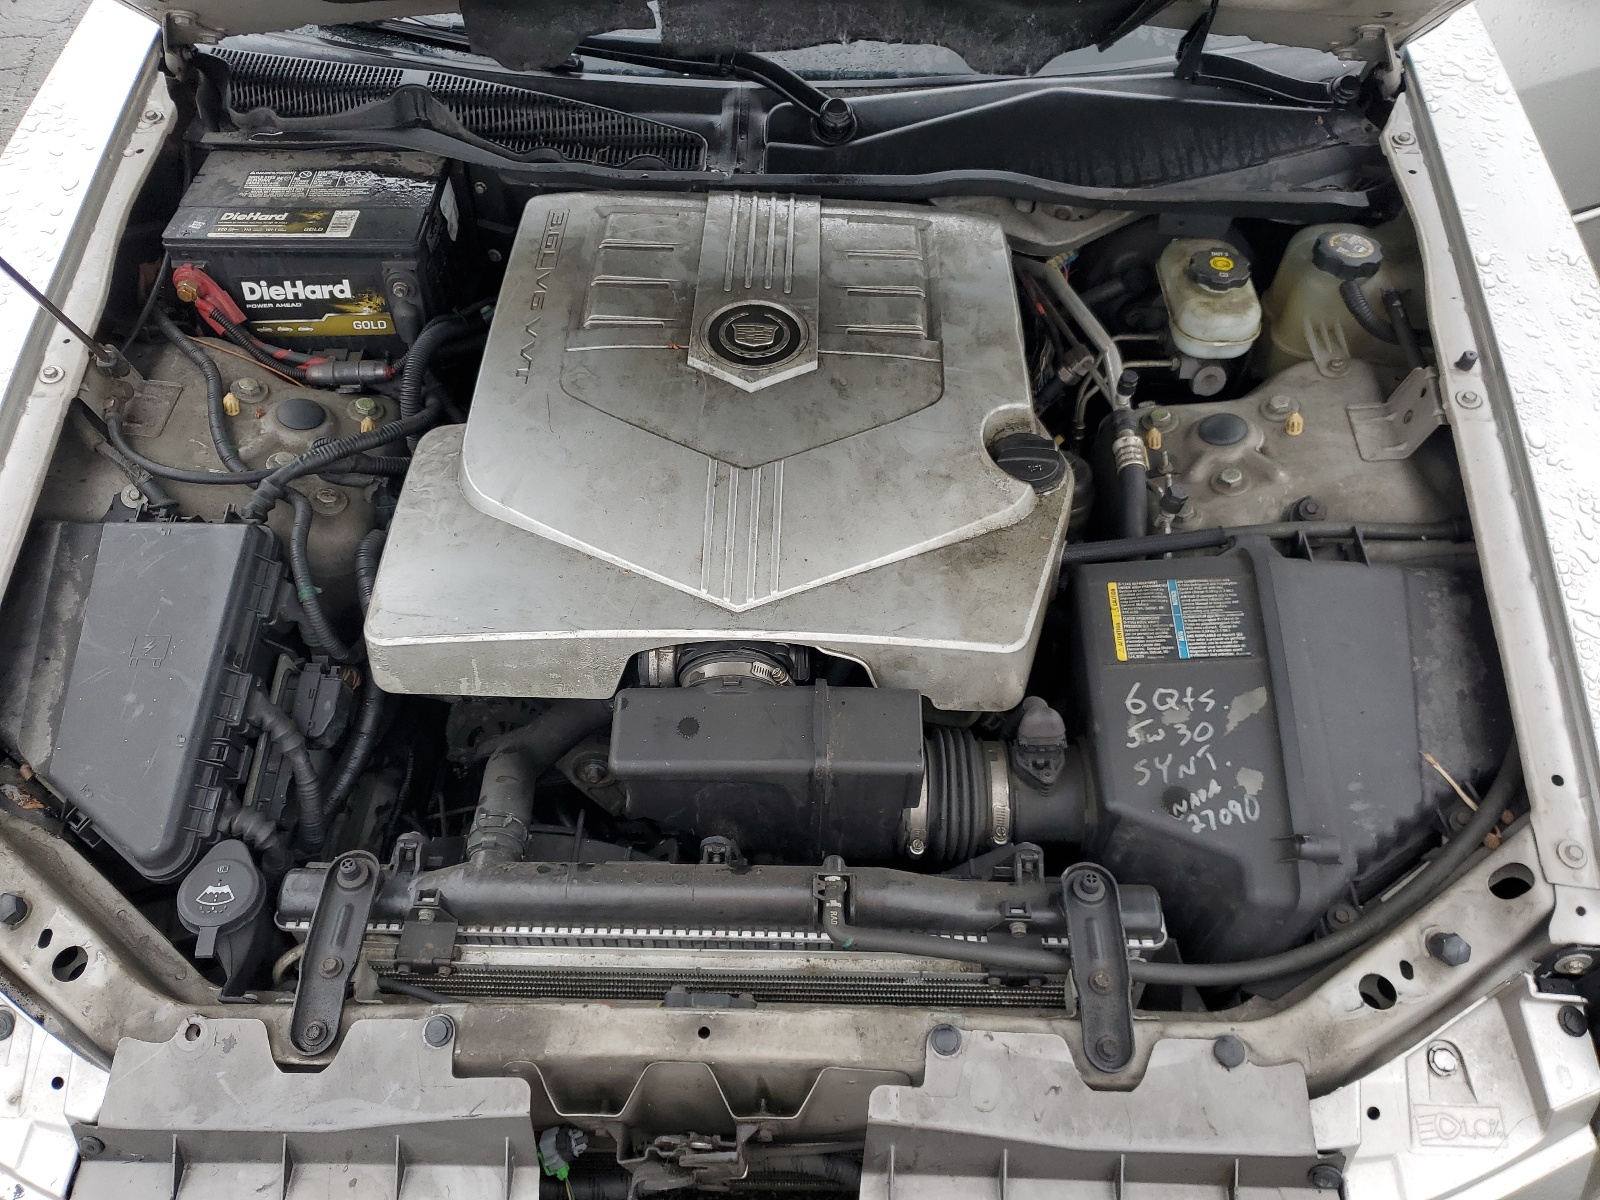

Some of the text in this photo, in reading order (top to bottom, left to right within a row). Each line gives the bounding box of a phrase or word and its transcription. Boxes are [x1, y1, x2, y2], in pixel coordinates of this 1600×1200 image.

[220, 211, 289, 221] DieHard
[241, 279, 352, 301] DieHard
[515, 211, 565, 385] 3.6L V6 VVT
[353, 320, 387, 330] GOLD
[1110, 588, 1118, 607] CAUTION
[1116, 622, 1124, 647] ATTENTION
[1124, 681, 1147, 715] 6
[1186, 793, 1260, 834] 27090
[830, 910, 838, 925] RAD
